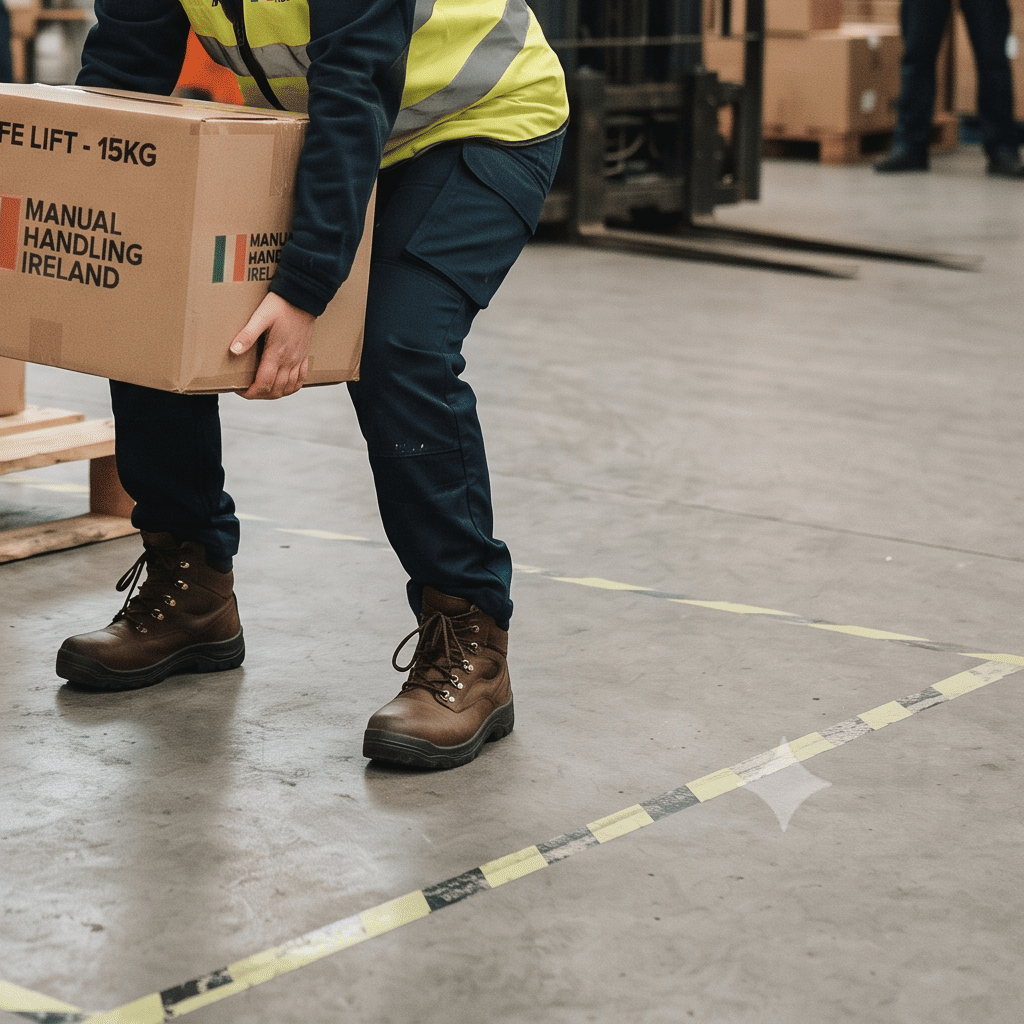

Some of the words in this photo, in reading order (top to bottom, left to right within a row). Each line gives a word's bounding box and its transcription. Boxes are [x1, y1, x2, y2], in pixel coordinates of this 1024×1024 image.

[30, 125, 79, 154] LIFT
[97, 136, 157, 168] 15KG
[25, 198, 122, 236] MANUAL
[23, 226, 143, 267] HANDLING
[21, 251, 120, 290] IRELAND
